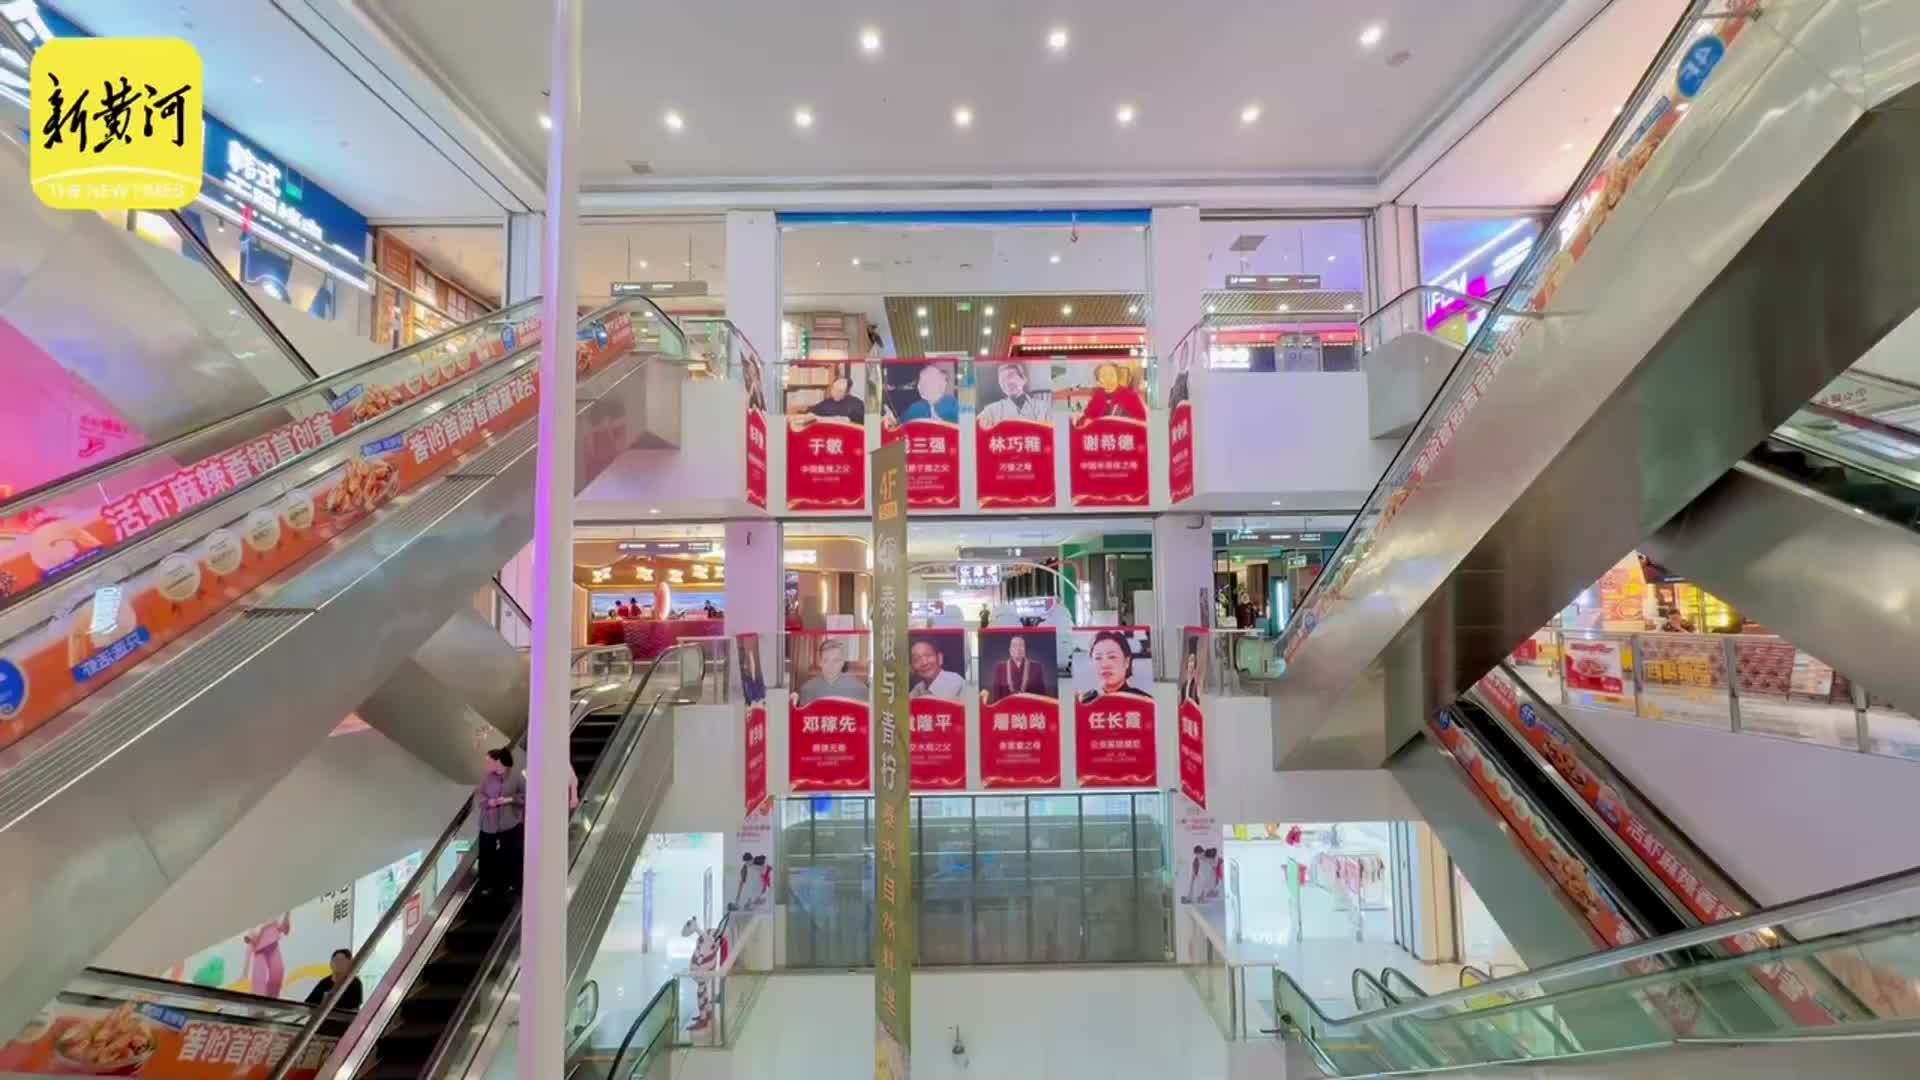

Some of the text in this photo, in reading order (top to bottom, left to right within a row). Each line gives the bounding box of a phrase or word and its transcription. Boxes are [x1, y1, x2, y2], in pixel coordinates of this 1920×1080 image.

[808, 437, 844, 455] 于敏
[989, 435, 1041, 453] 林巧稚
[1082, 433, 1135, 452] 谢希德
[104, 414, 335, 542] 活虾麻辣香锅首创者
[802, 715, 857, 734] 邓稼先
[993, 712, 1046, 731] 屠呦呦
[1088, 711, 1142, 730] 任长霞
